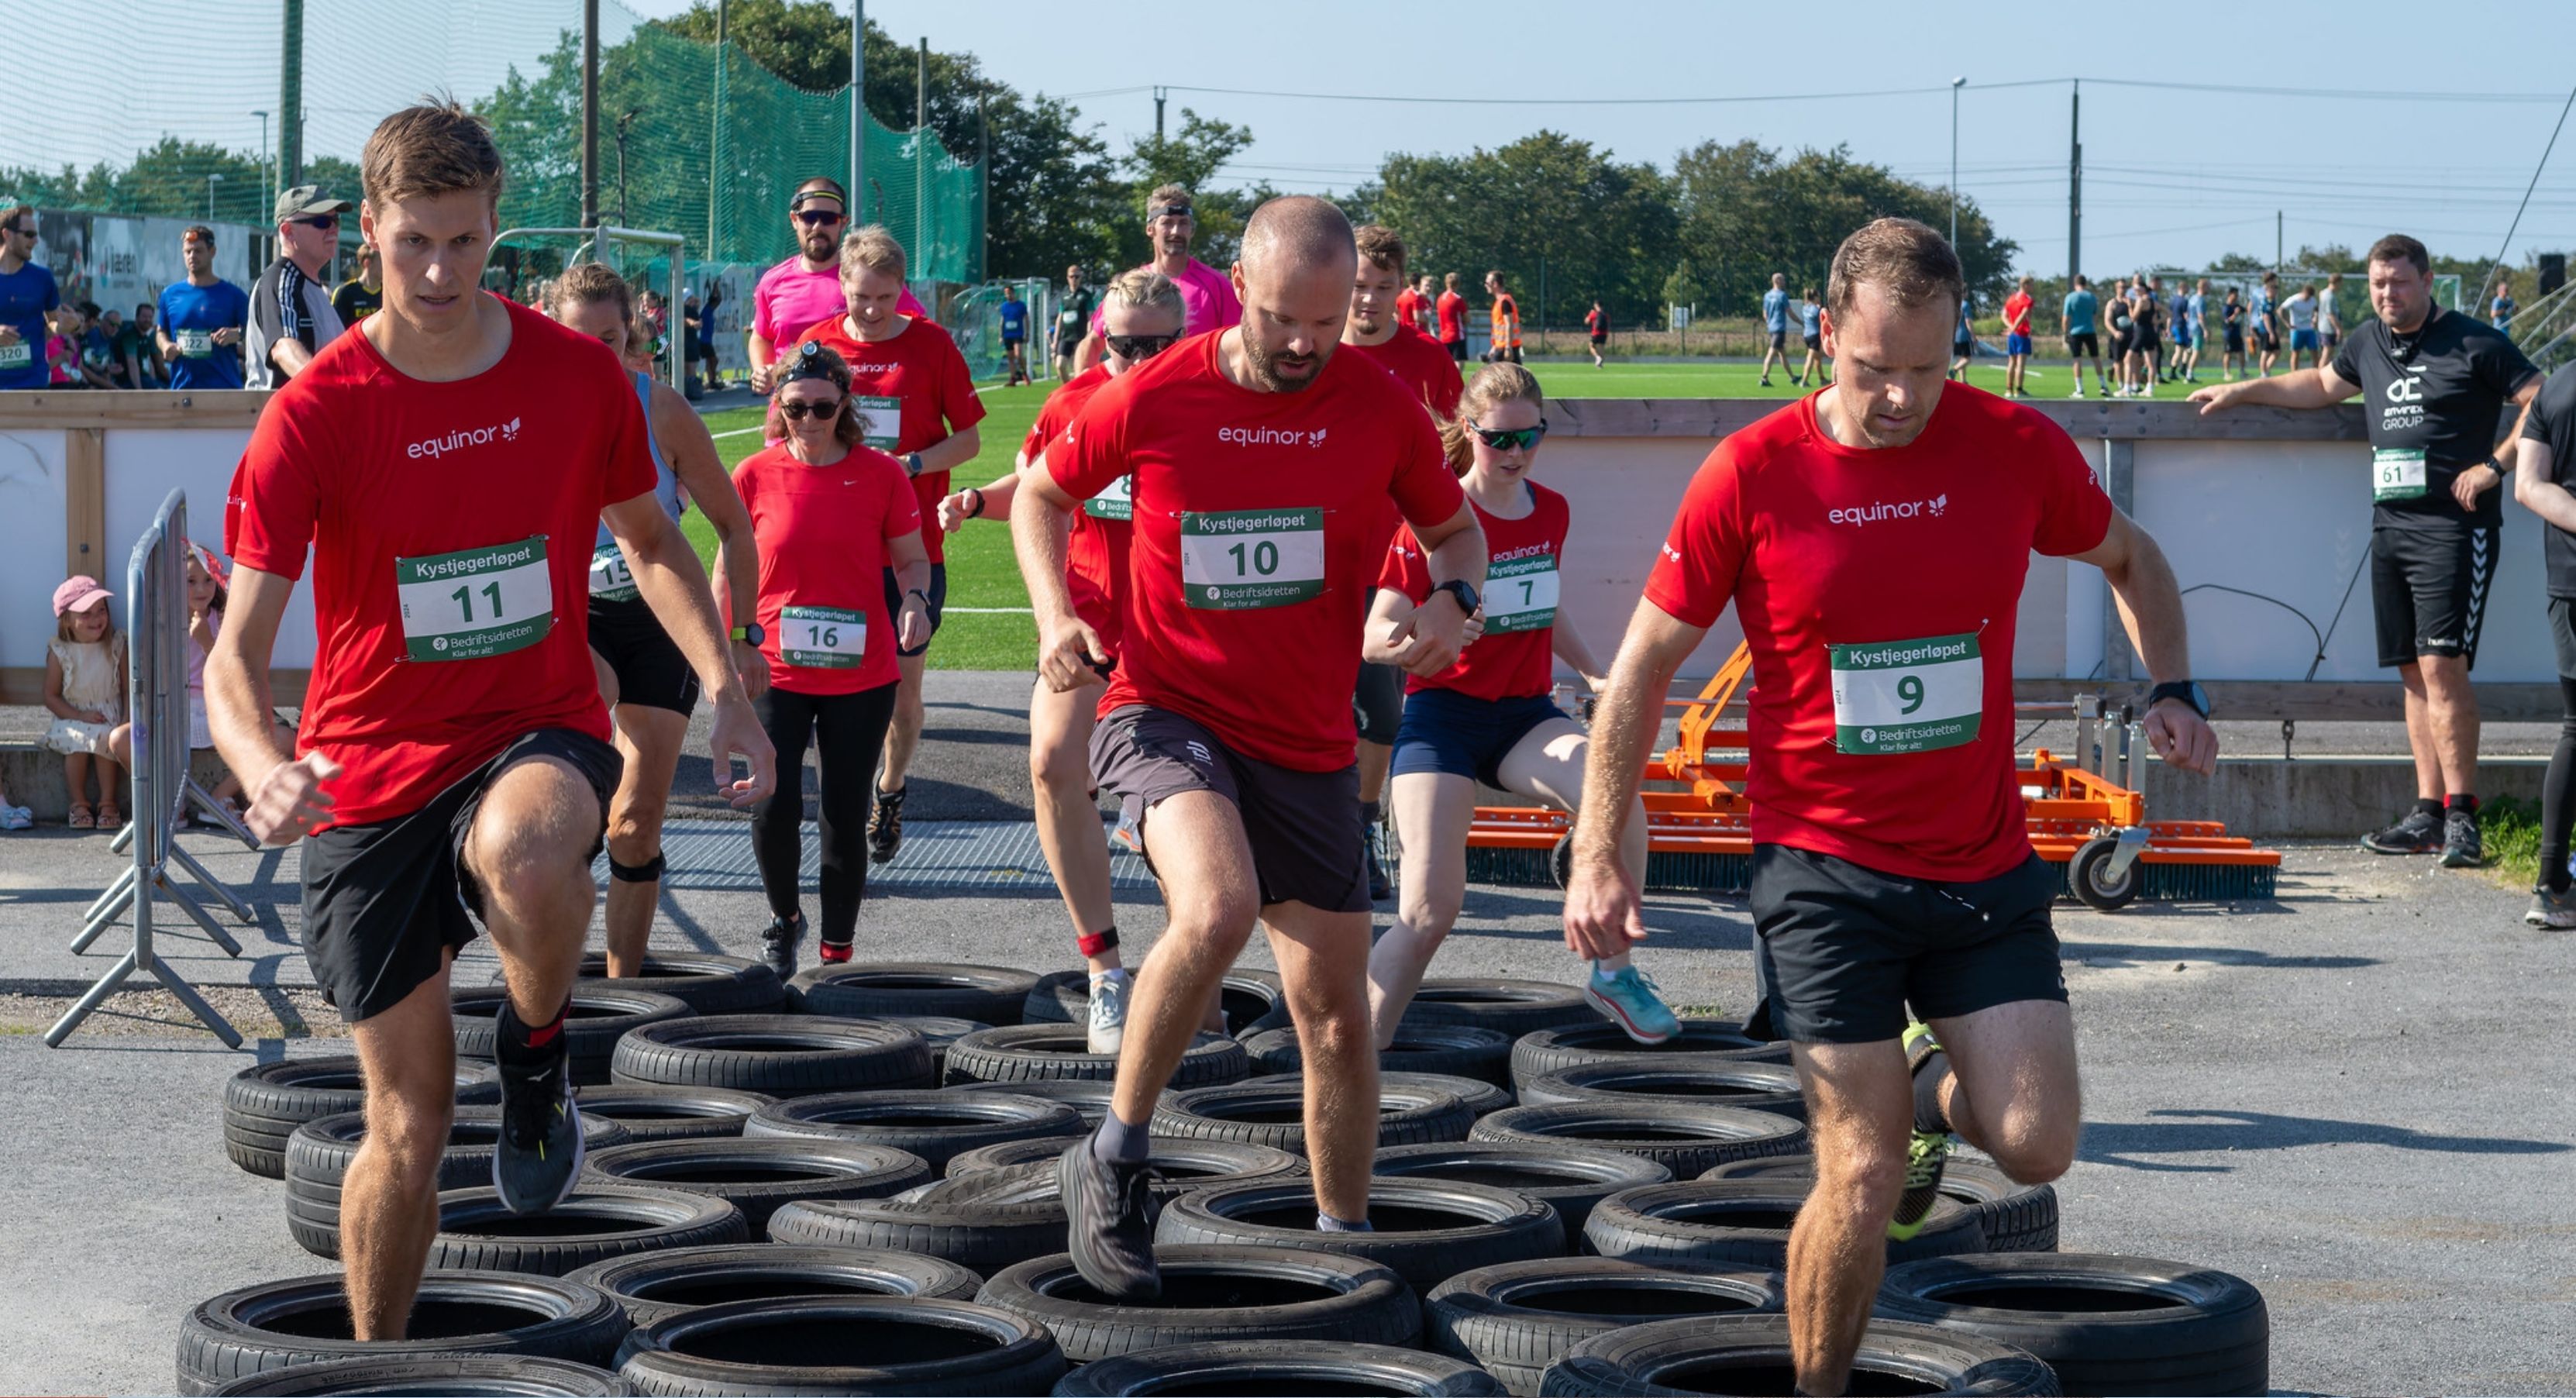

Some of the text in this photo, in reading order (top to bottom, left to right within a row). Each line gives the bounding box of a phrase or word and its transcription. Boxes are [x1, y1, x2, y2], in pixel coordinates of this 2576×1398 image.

[849, 363, 886, 375] quinor
[2382, 415, 2424, 430] GROUP
[407, 425, 498, 459] equinor
[1218, 426, 1304, 447] equinor
[2383, 466, 2401, 483] 61
[1199, 515, 1306, 533] Kystjegerløpet
[1828, 501, 1923, 527] equinor
[416, 546, 531, 579] Kystjegerløpet
[1228, 540, 1279, 577] 10
[600, 559, 633, 585] 15
[451, 581, 503, 623] 11
[1223, 586, 1300, 599] Bedriftsidretten
[1518, 580, 1533, 606] 7
[451, 625, 533, 649] Bedriftsidretten
[808, 625, 838, 648] 16
[1850, 641, 1966, 667] Kystjegerløpet
[1897, 675, 1924, 715] 9
[1879, 723, 1961, 741] Bedriftsidretten
